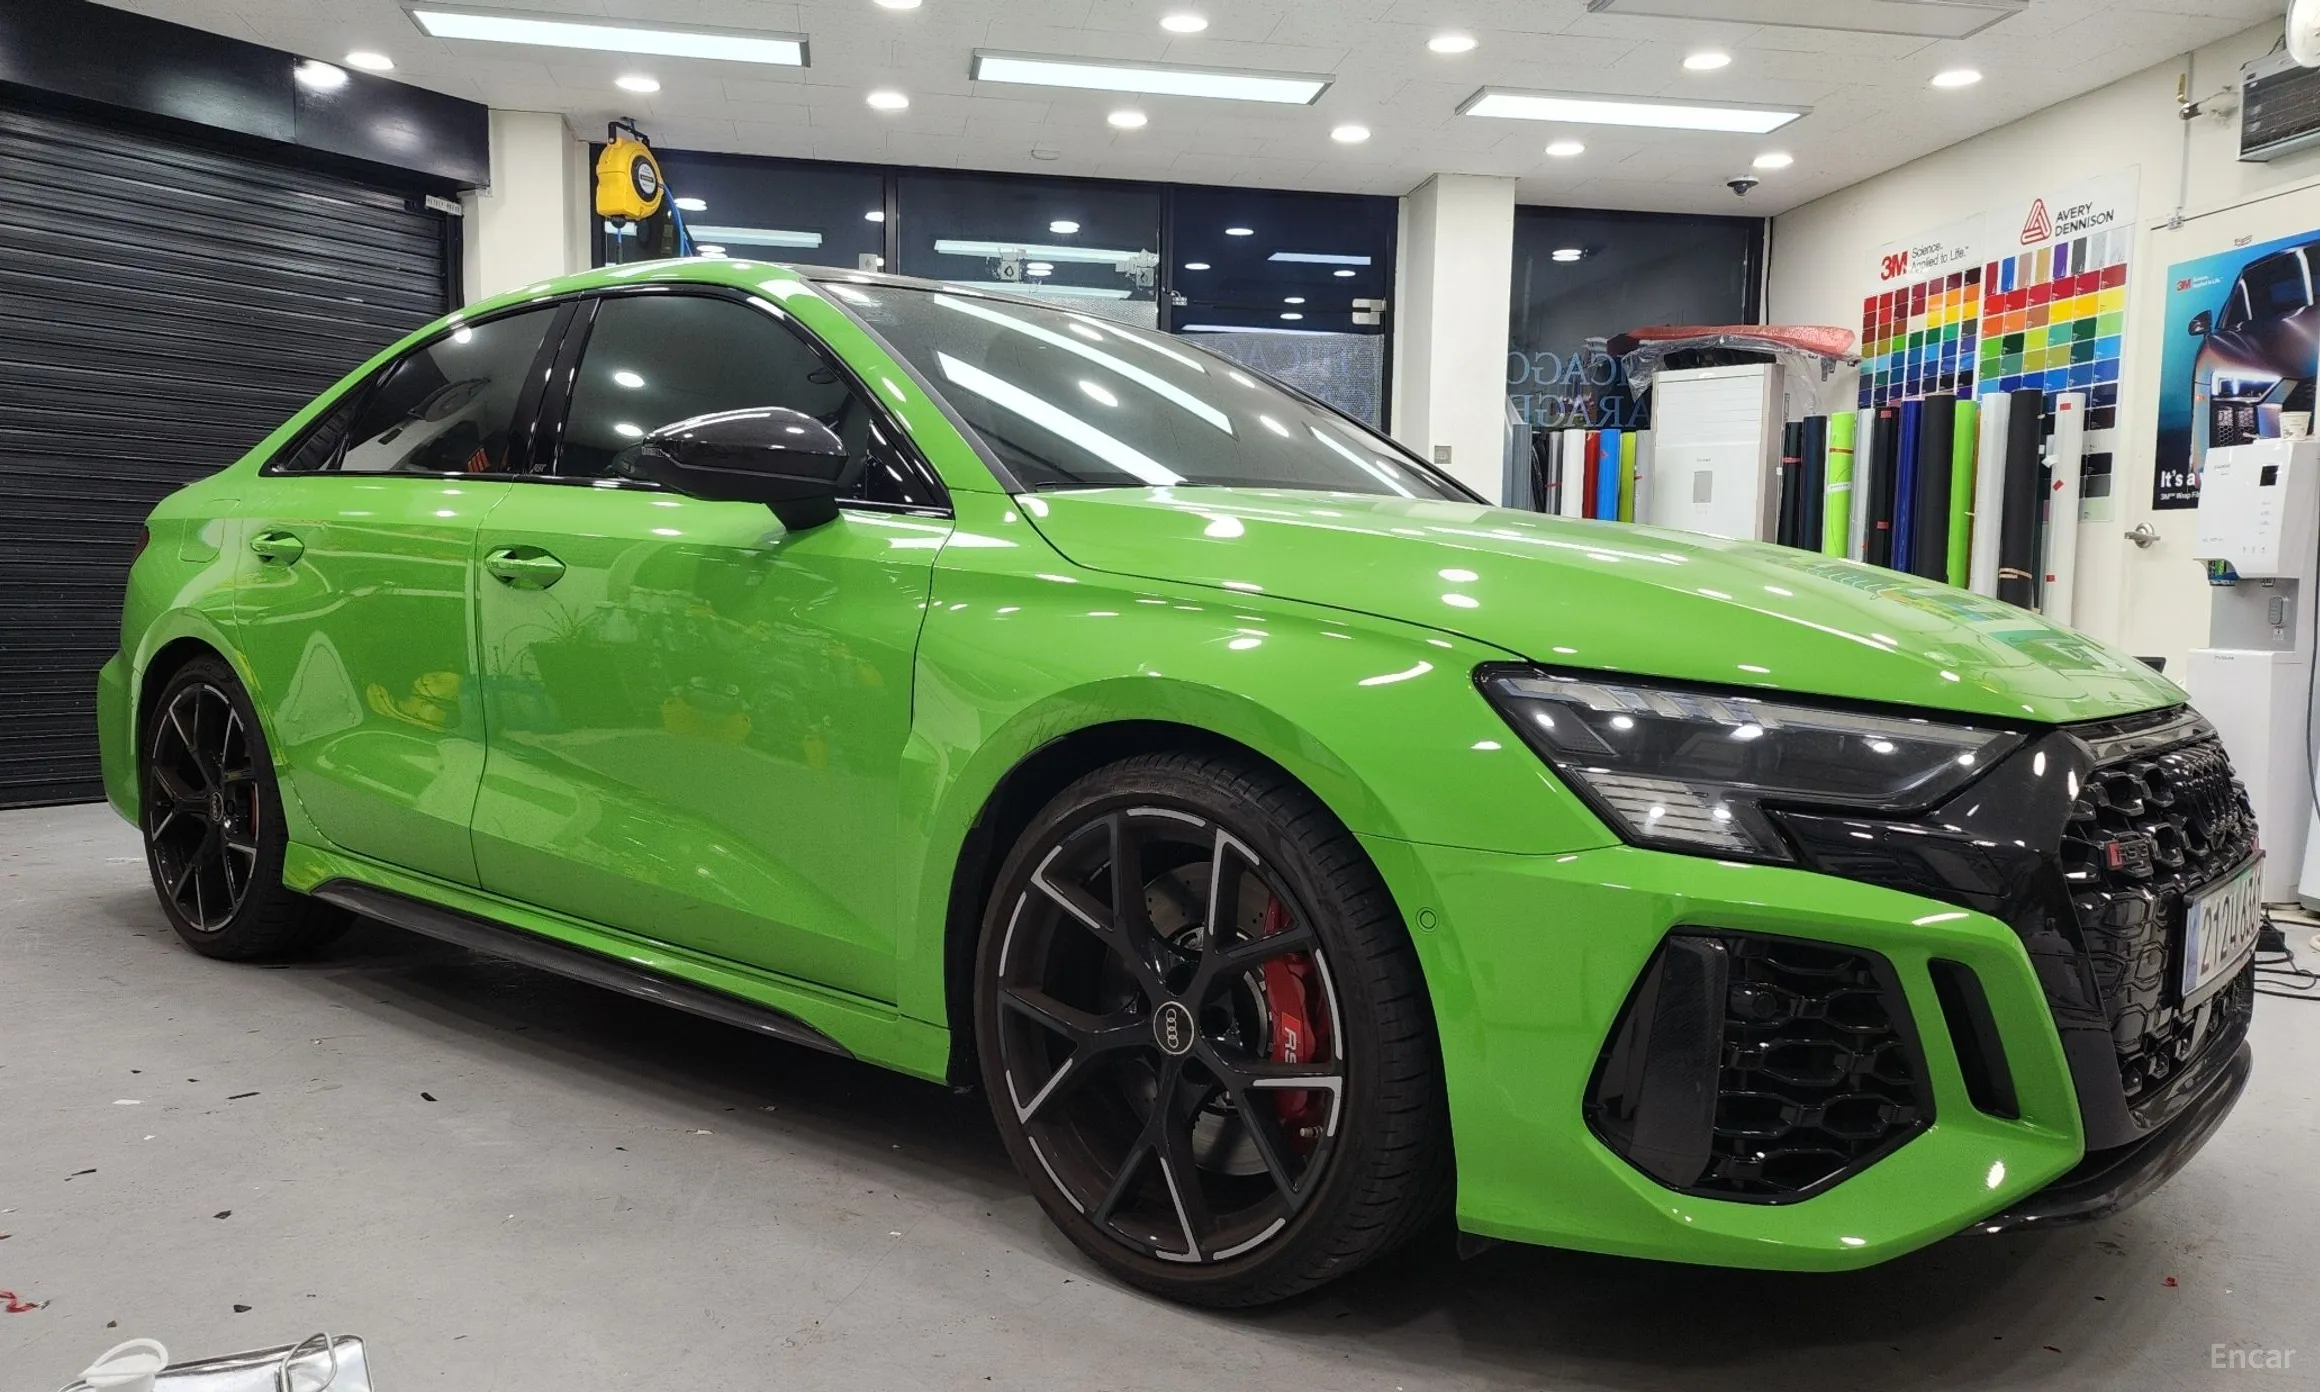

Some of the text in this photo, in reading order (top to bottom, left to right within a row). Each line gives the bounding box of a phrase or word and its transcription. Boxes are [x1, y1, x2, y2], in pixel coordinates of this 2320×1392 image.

[2056, 202, 2093, 223] AVERY
[2055, 209, 2114, 237] DENNISON
[1881, 250, 1908, 282] 3M
[1940, 253, 1948, 264] to
[2177, 278, 2191, 292] 3M
[2186, 473, 2195, 486] a
